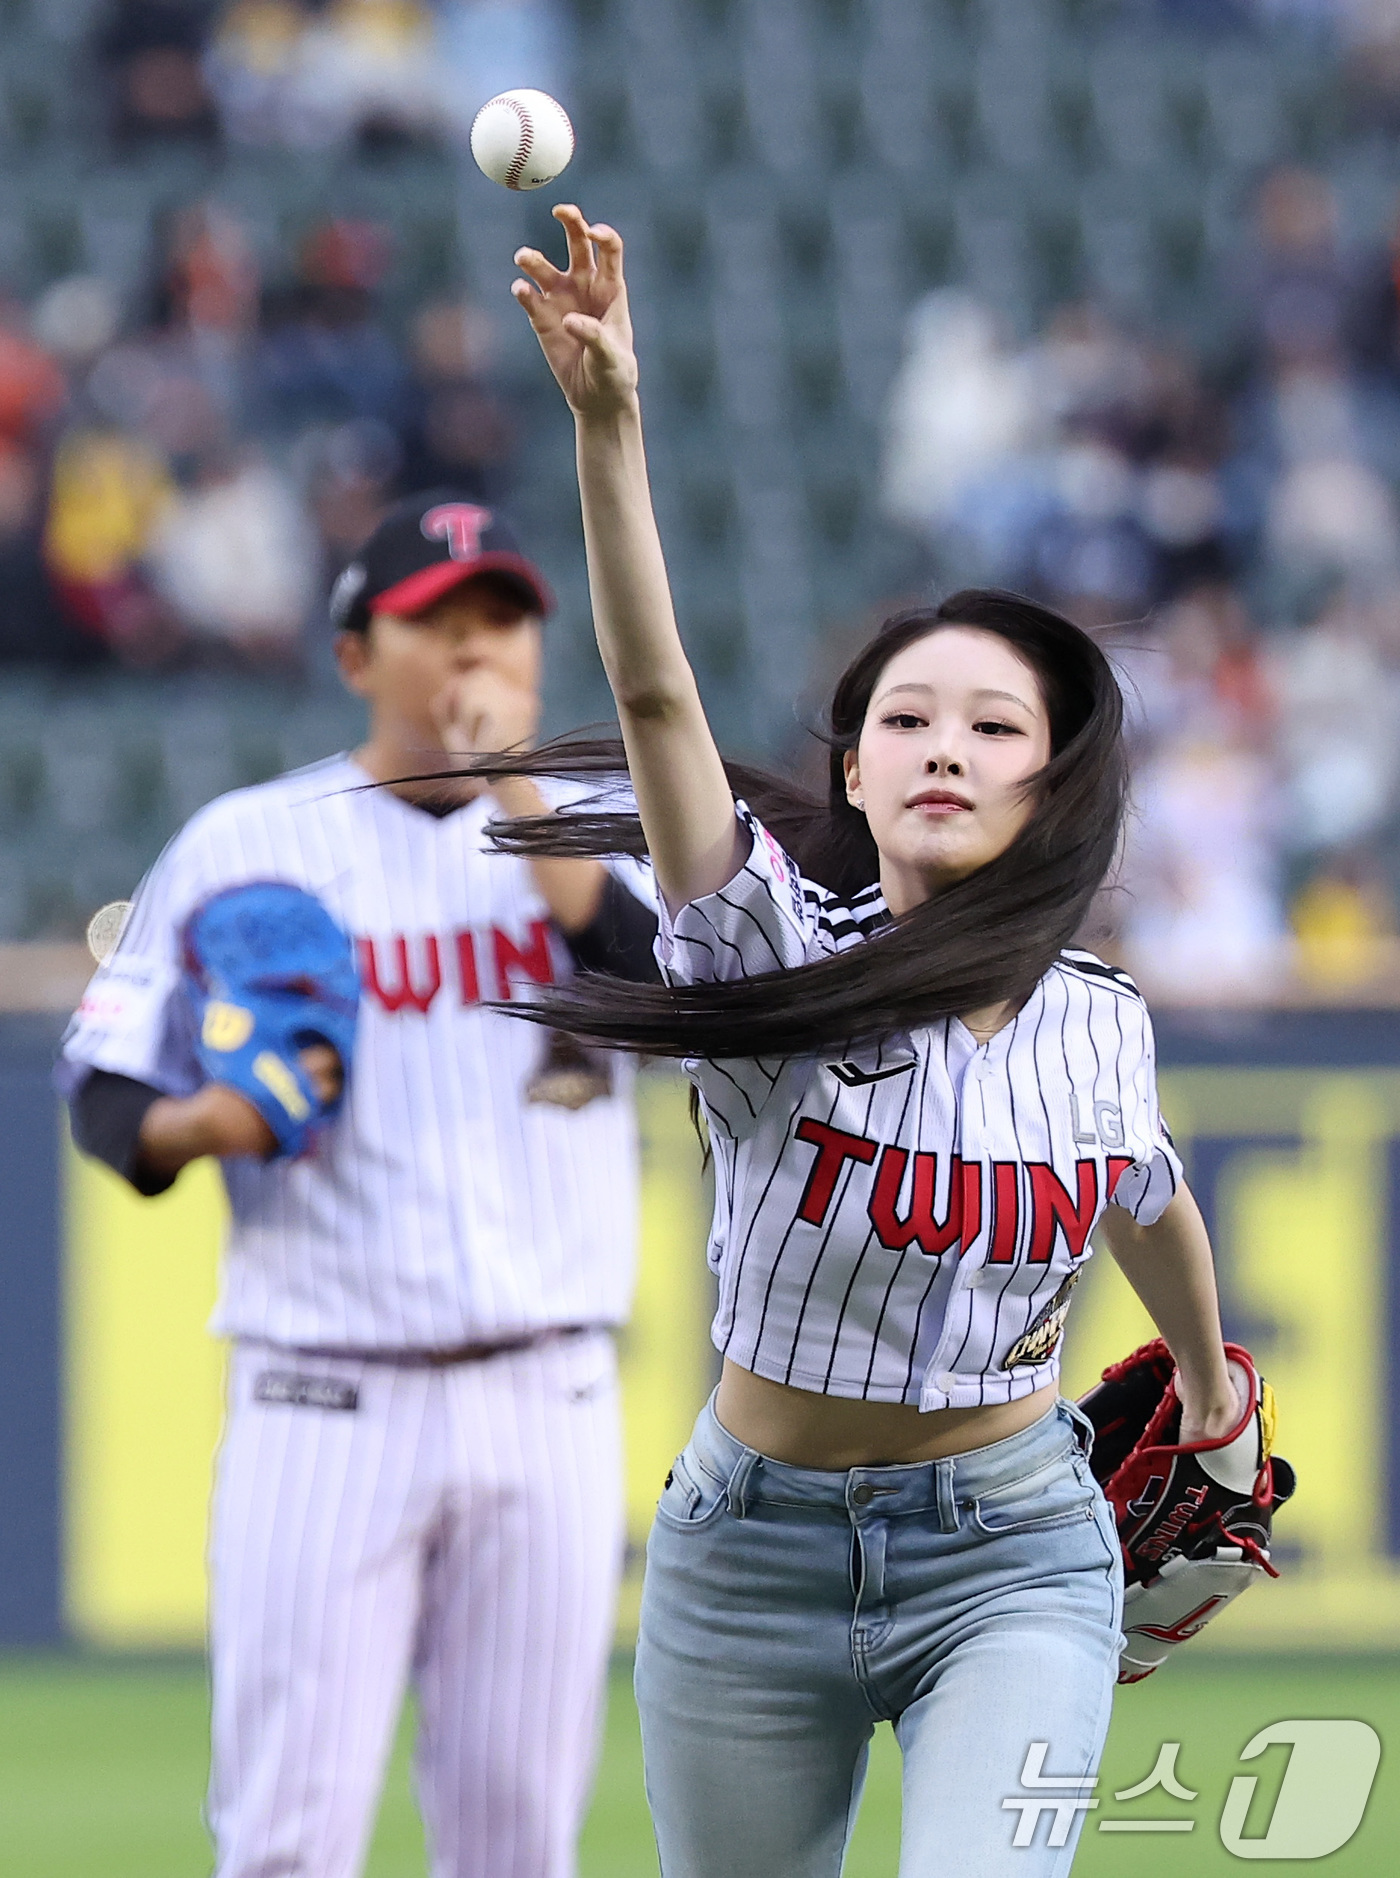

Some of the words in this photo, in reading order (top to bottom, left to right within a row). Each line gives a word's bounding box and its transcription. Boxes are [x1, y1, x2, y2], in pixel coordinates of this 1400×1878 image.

[420, 502, 493, 562] T
[1068, 1092, 1125, 1149] LG
[1135, 1484, 1209, 1562] TWINS
